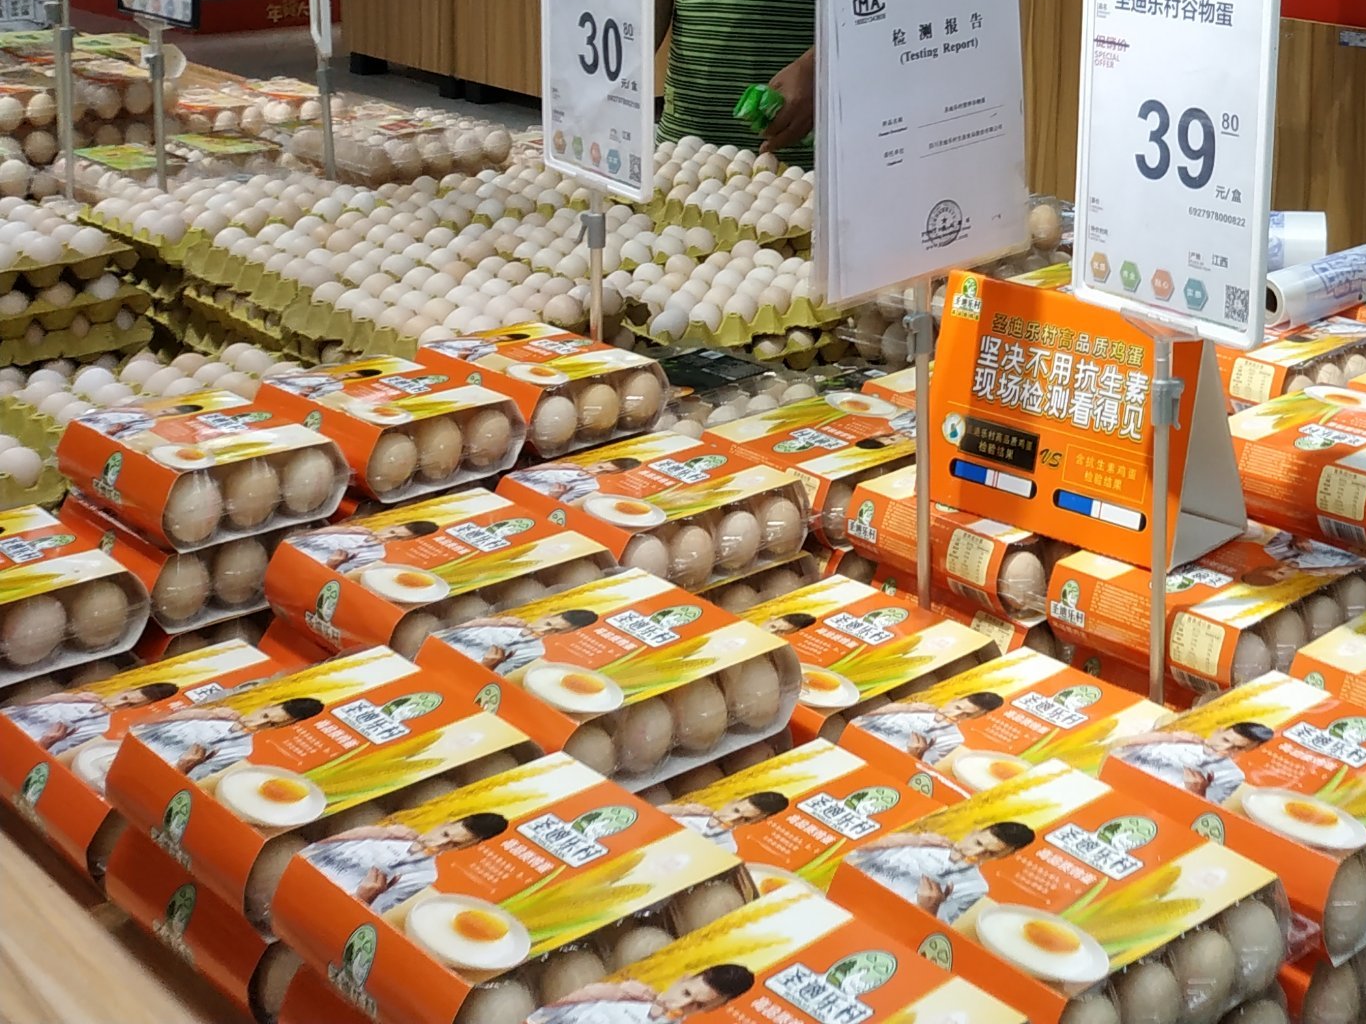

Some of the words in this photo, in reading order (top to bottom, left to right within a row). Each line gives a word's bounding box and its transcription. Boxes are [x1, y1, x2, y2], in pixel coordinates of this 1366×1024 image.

[892, 12, 983, 47] 检测报告
[578, 11, 623, 82] 30
[623, 22, 634, 38] 80
[900, 47, 938, 65] (Testing
[943, 37, 979, 53] Report)
[1095, 50, 1120, 63] SPECIAL
[1095, 59, 1114, 69] OFFER
[1135, 99, 1216, 190] 39
[1221, 112, 1240, 134] 80
[1215, 185, 1242, 204] 元/盒
[1188, 206, 1247, 228] 6927978000822
[1212, 254, 1229, 269] 江西
[992, 312, 1145, 368] 圣迪乐村高品质鸡蛋
[977, 334, 1149, 405] 坚决不用抗生素
[973, 367, 1144, 440] 现场检测看得见
[978, 442, 1014, 461] 检验结果
[1040, 448, 1063, 469] VS
[1074, 454, 1137, 481] 含抗生素鸡蛋
[1084, 472, 1123, 492] 检验结果
[1051, 603, 1084, 626] 圣迪乐村
